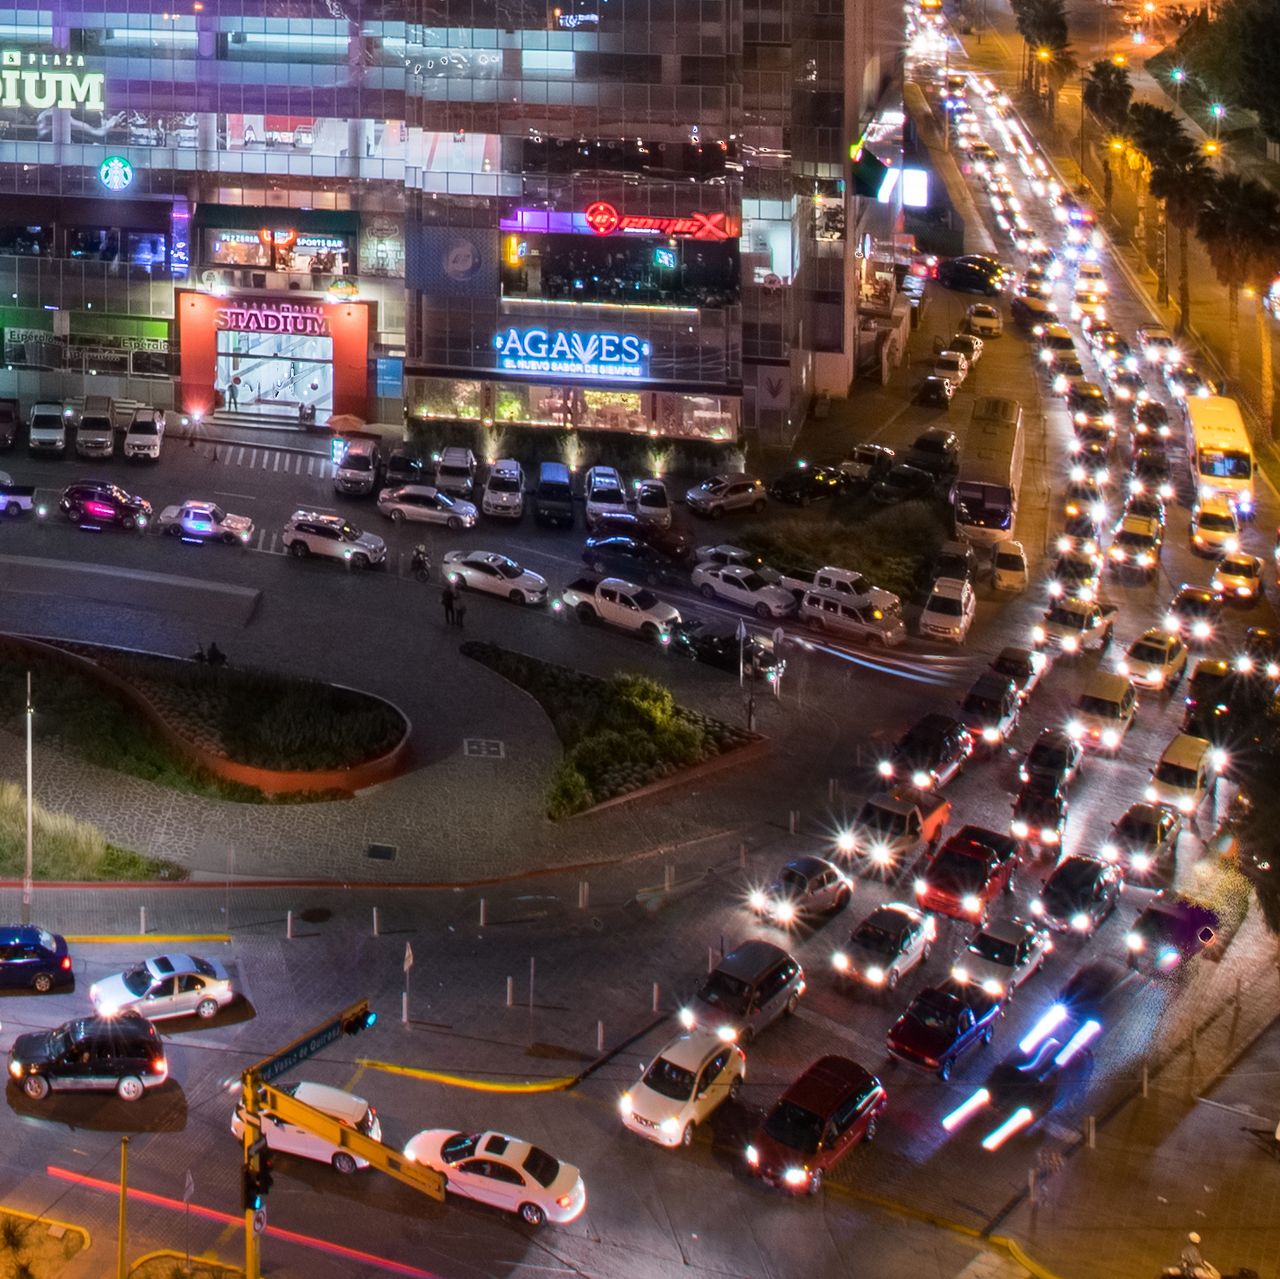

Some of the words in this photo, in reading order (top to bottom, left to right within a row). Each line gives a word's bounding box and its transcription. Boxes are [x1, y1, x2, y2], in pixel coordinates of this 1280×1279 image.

[29, 52, 85, 66] PLAZA
[221, 233, 260, 244] PIZZERIA
[296, 238, 326, 247] SPORTS
[326, 239, 343, 248] BAR
[216, 308, 331, 334] STADIUM
[501, 328, 640, 364] AGAVES
[505, 358, 516, 369] EL
[517, 360, 550, 370] NUEVO
[551, 362, 582, 372] SABOR
[587, 364, 599, 373] DE
[600, 365, 641, 376] SIEMPRE
